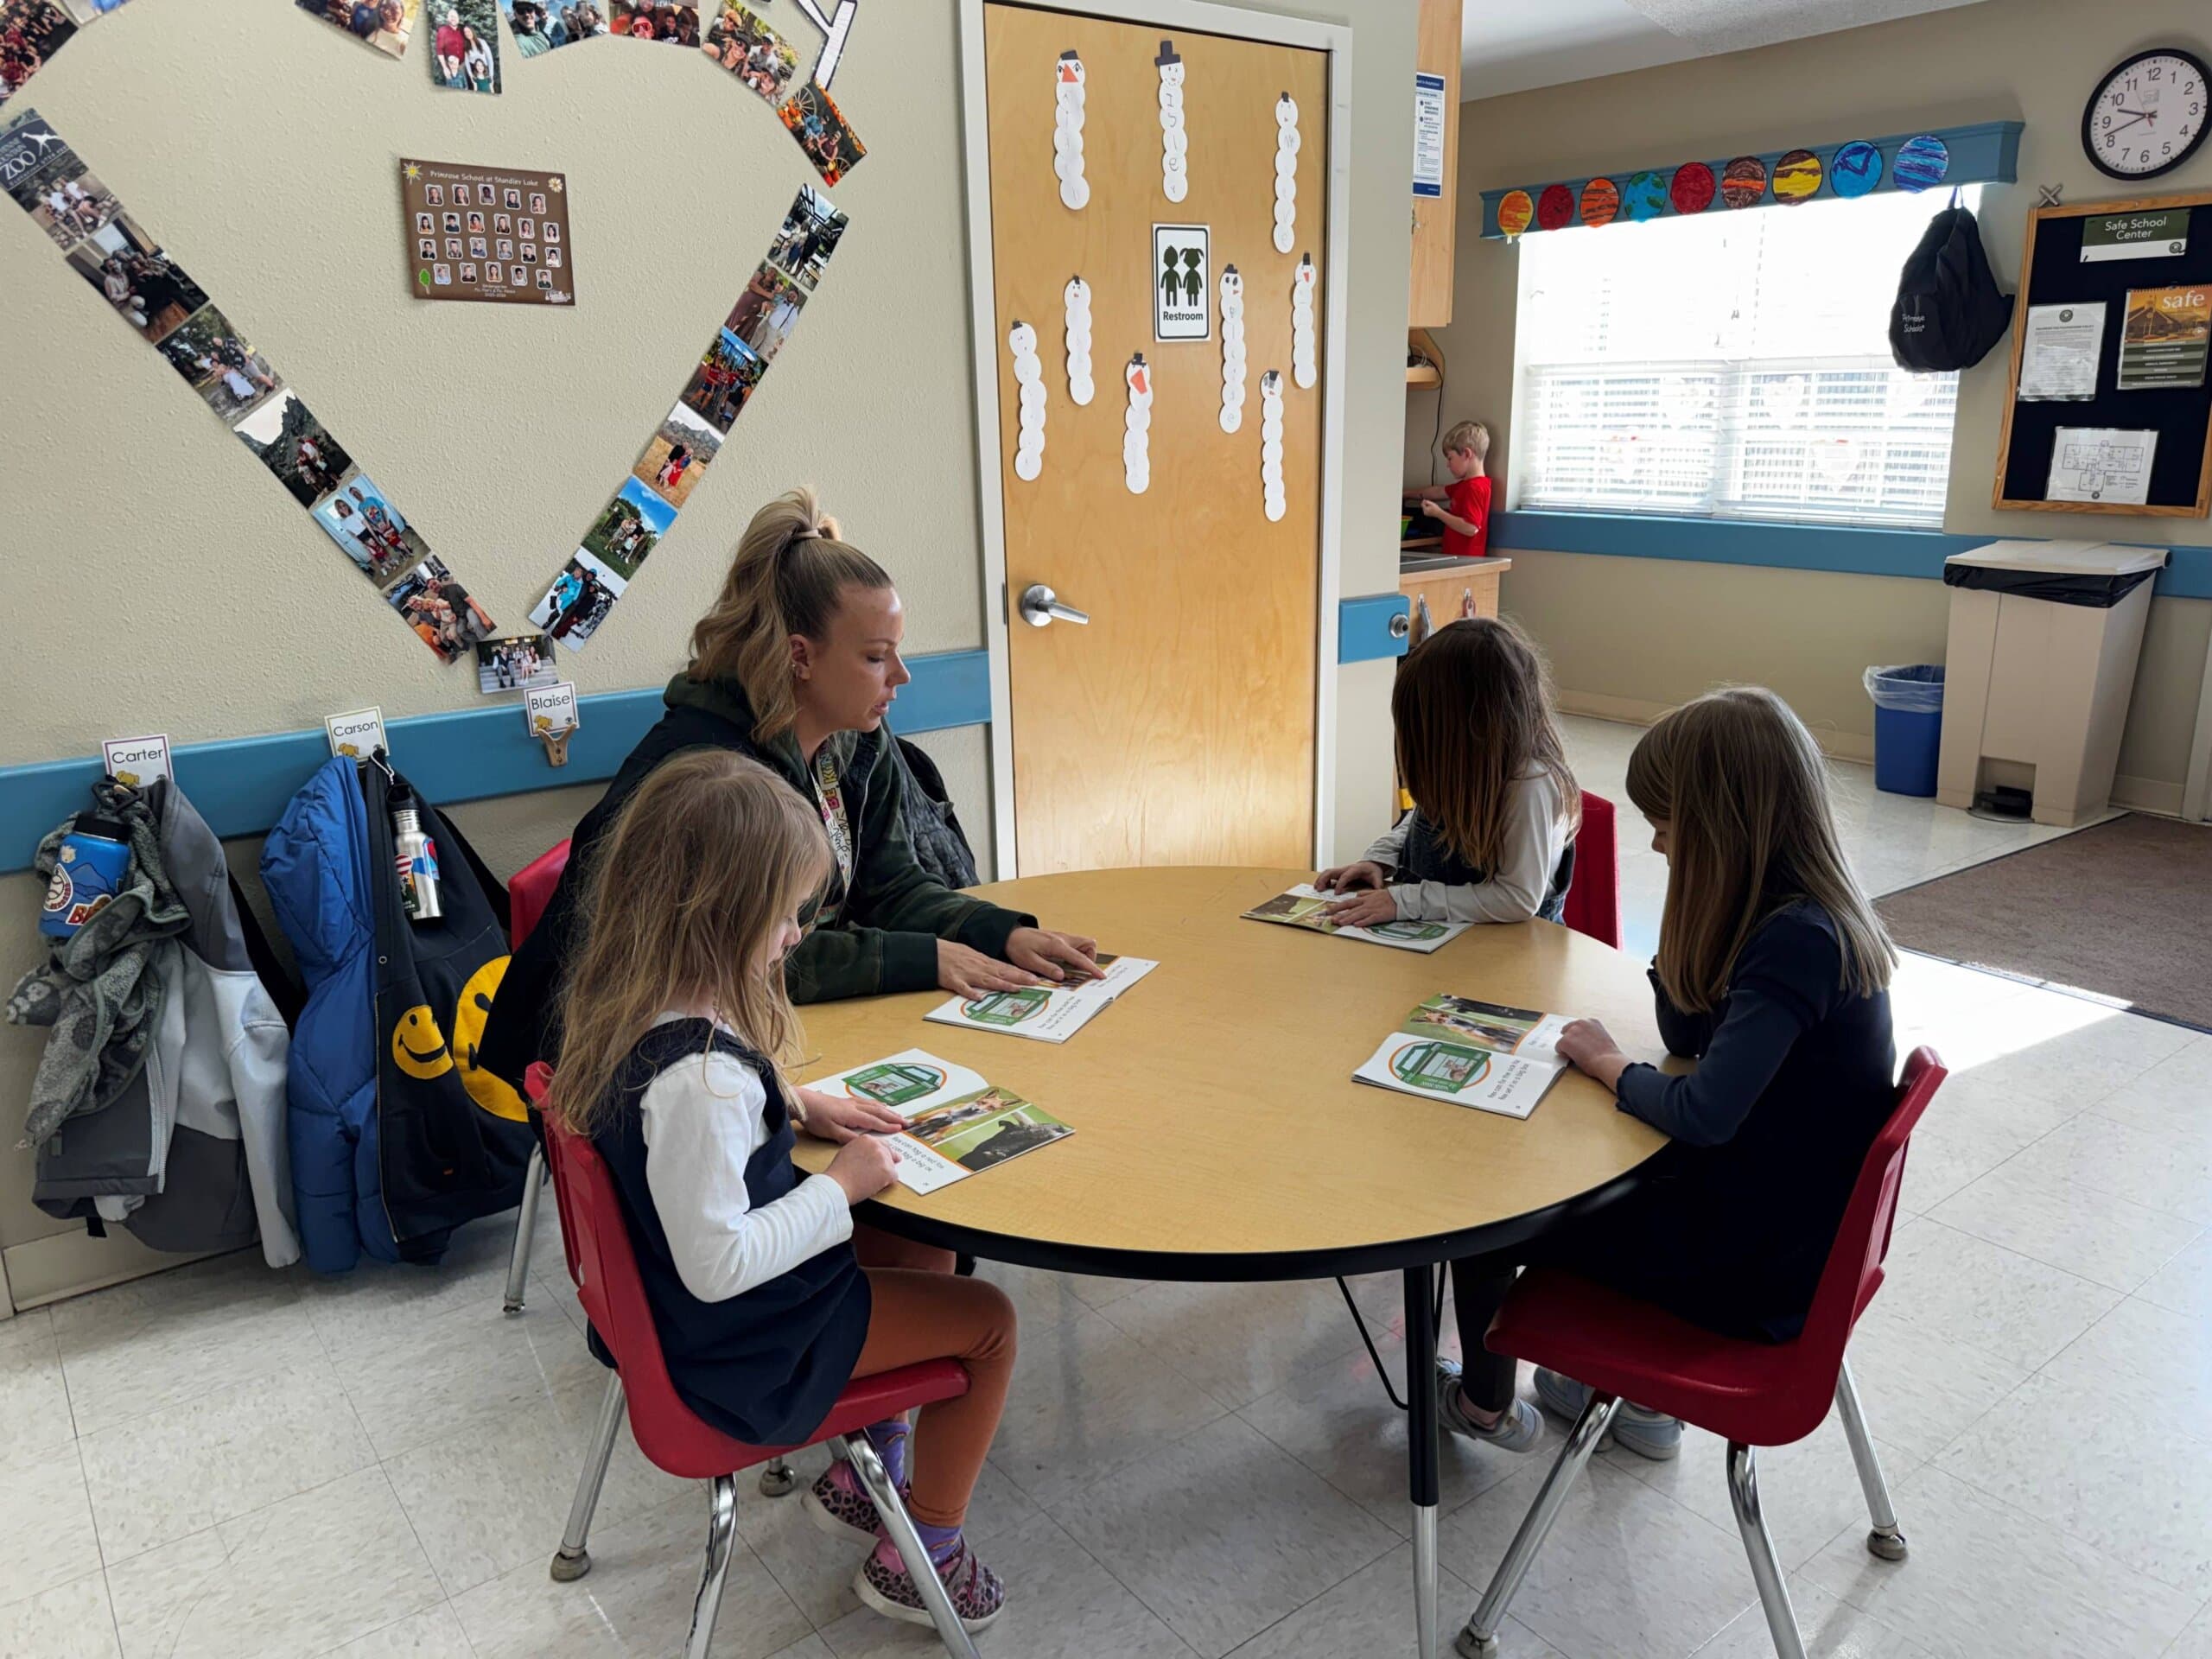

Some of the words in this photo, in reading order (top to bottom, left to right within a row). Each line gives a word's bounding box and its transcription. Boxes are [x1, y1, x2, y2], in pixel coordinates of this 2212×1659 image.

[2146, 67, 2161, 81] 12
[2171, 71, 2177, 84] 1
[2126, 78, 2138, 92] 11
[2184, 81, 2194, 95] 2
[2110, 92, 2125, 106] 10
[2189, 102, 2199, 116] 3
[2101, 116, 2111, 129] 9
[2179, 124, 2189, 137] 4
[2106, 135, 2115, 148] 8
[2162, 142, 2171, 155] 5
[2122, 148, 2131, 161] 7
[2139, 149, 2150, 162] 6
[0, 150, 36, 181] ZOO
[429, 170, 460, 181] Primrose
[461, 174, 485, 182] School
[2105, 219, 2128, 232] Safe
[2130, 216, 2167, 229] School
[2116, 230, 2153, 240] Center
[2162, 289, 2205, 309] safe
[1163, 311, 1204, 322] Restroom
[531, 694, 570, 710] Blaise
[333, 720, 379, 737] Carson
[111, 748, 163, 764] Carter
